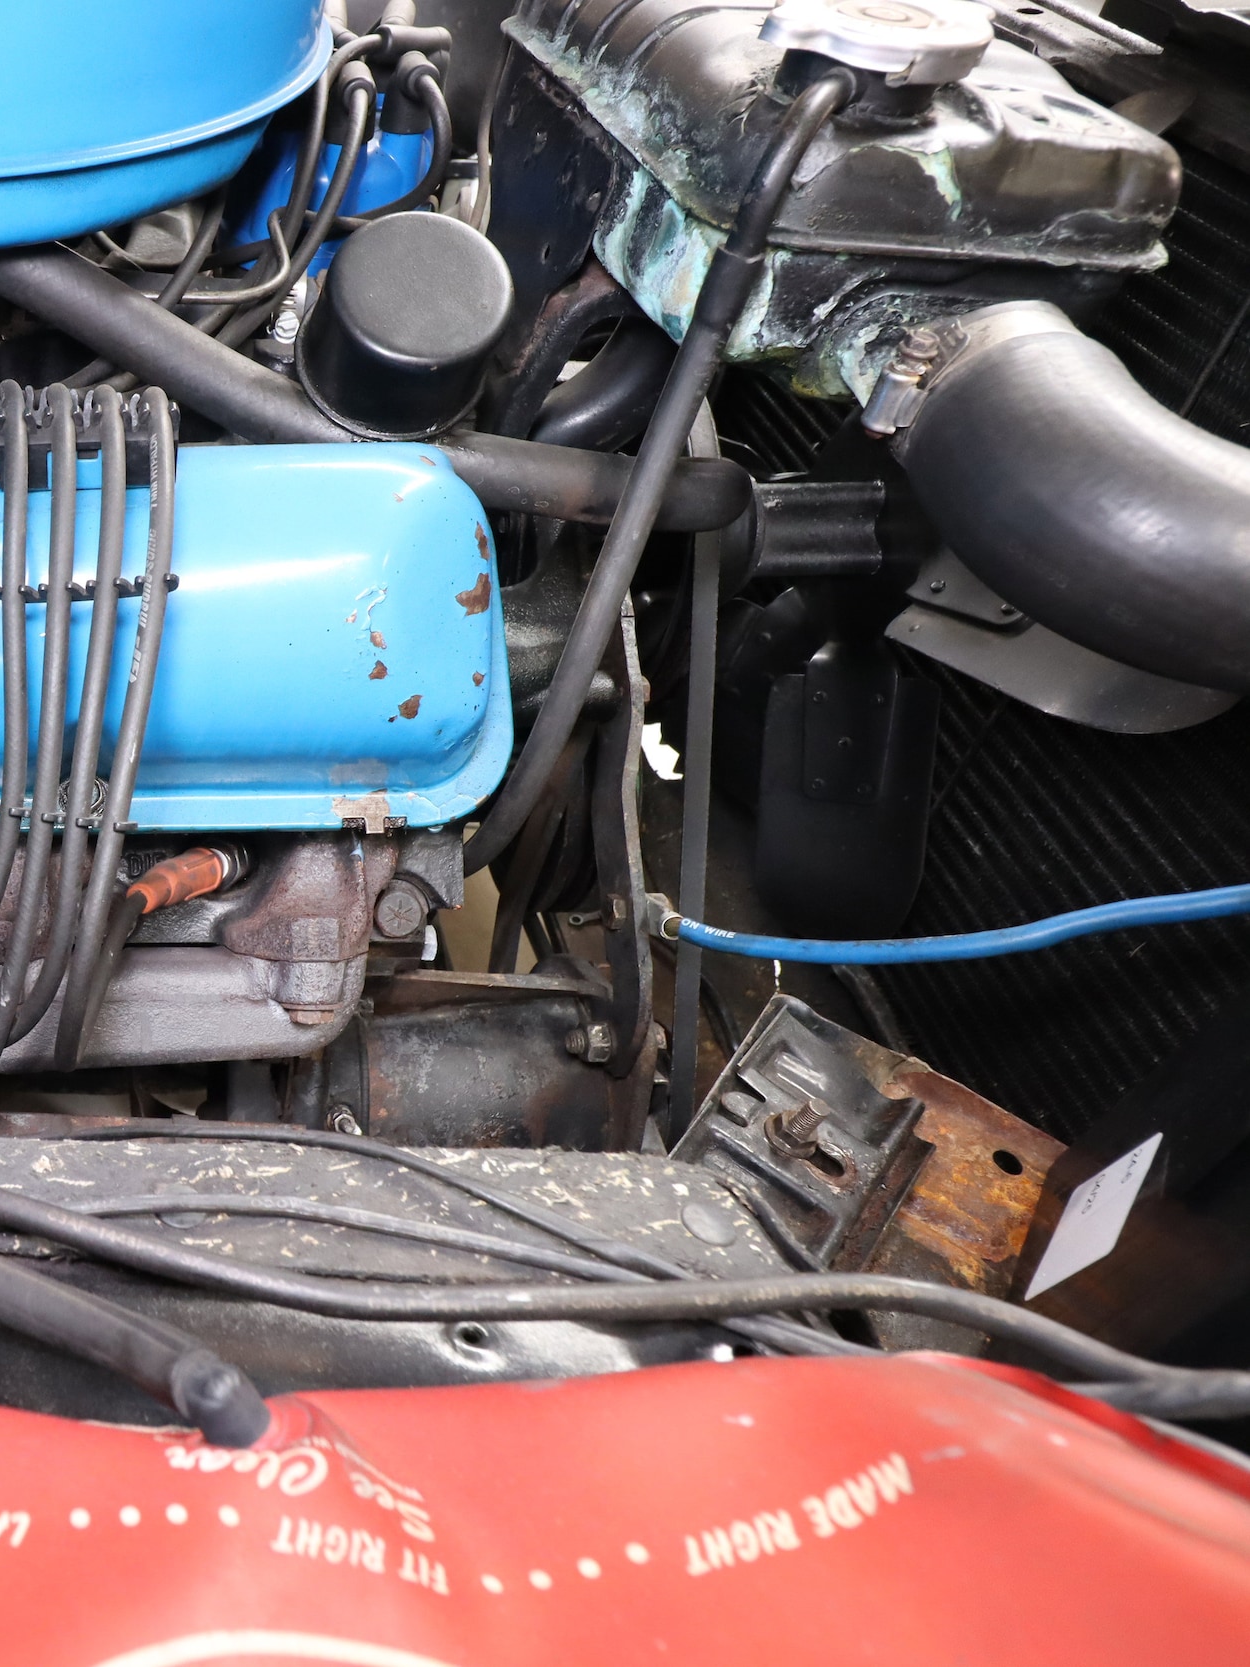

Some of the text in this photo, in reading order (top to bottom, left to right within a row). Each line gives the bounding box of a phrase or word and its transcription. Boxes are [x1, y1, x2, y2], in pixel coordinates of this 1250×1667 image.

[680, 917, 738, 939] ON WIRE
[164, 1445, 329, 1497] Clear
[800, 1450, 915, 1539] MADE
[269, 1514, 387, 1575] RIGHT
[683, 1507, 802, 1577] RIGHT
[397, 1546, 450, 1597] FIT
